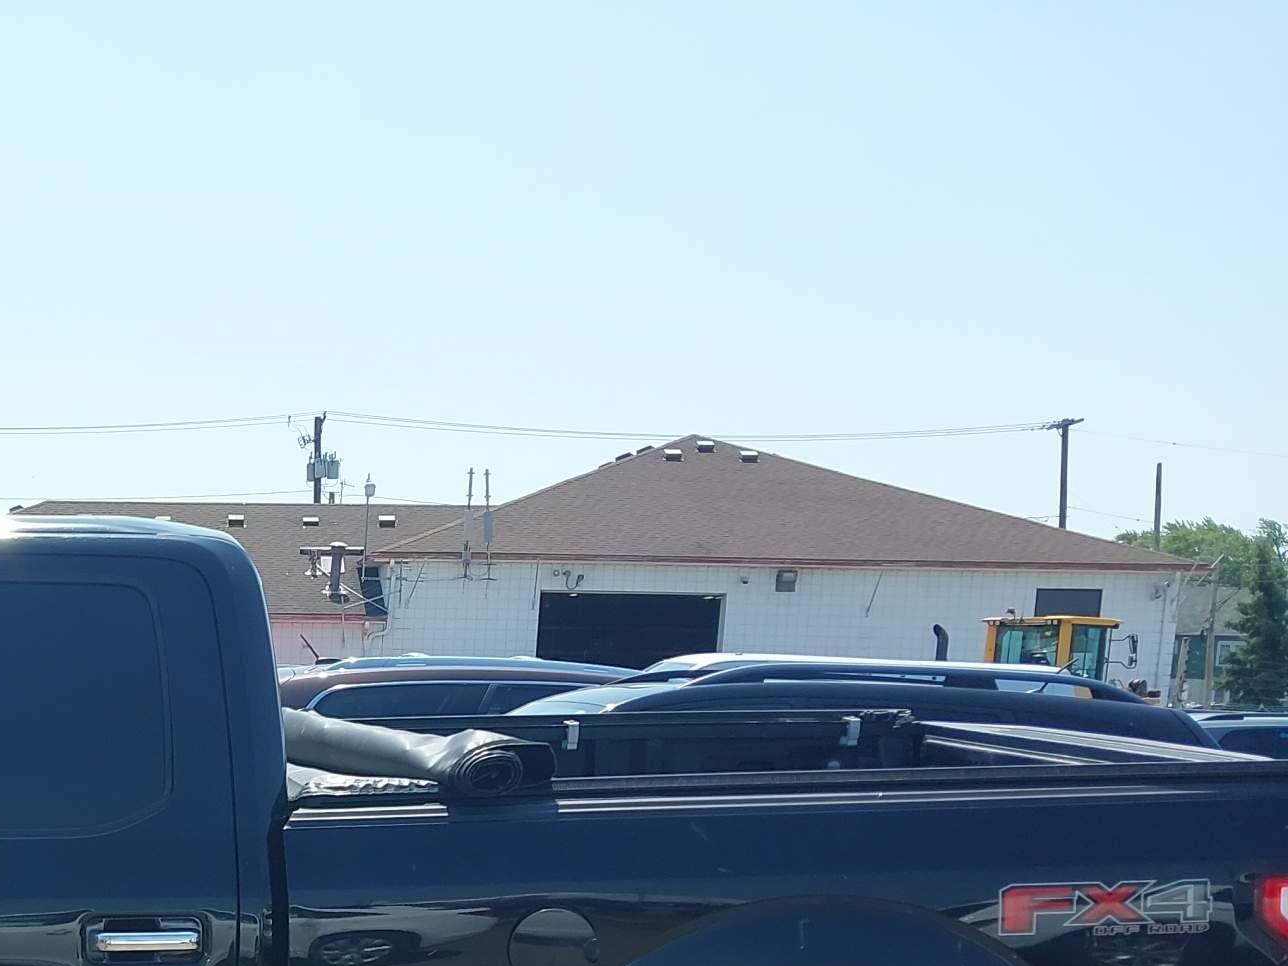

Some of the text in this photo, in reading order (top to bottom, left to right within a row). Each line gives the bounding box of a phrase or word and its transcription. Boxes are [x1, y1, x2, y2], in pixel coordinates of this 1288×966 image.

[998, 879, 1213, 936] FX4
[1093, 923, 1210, 936] OFF ROAD
